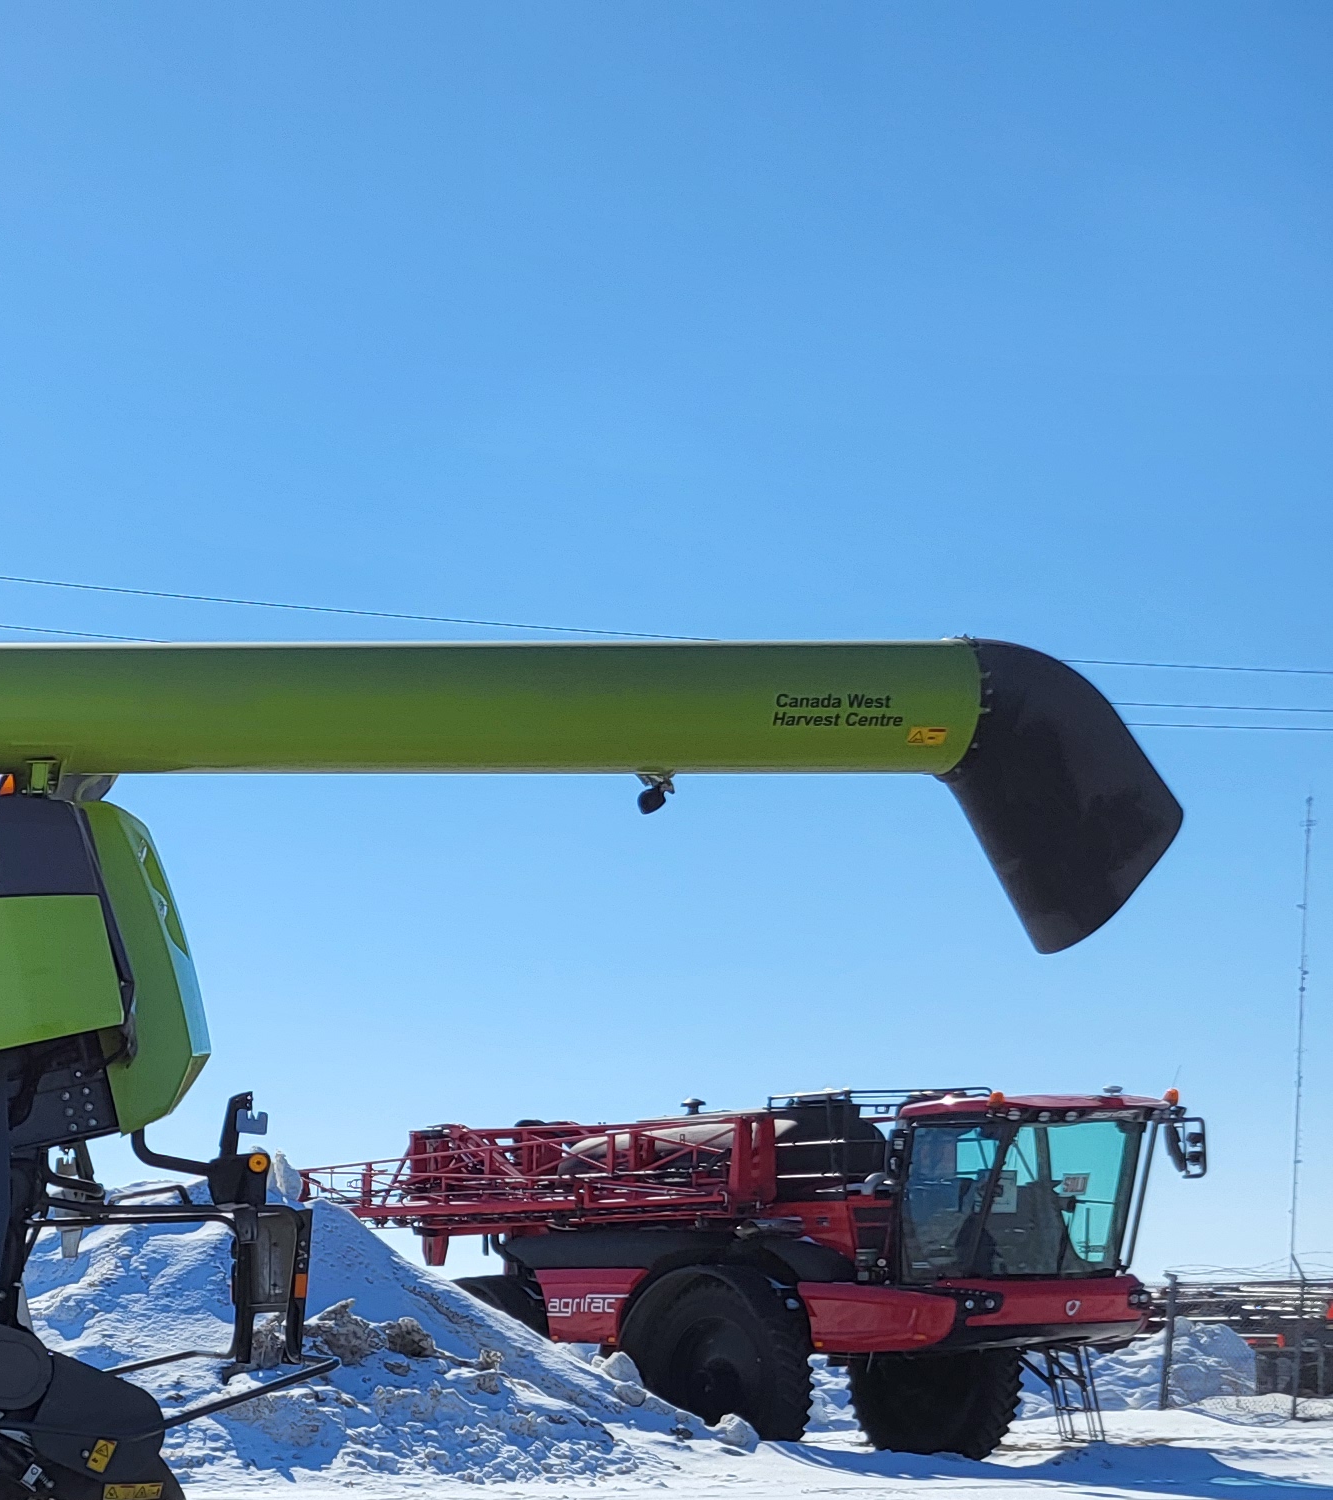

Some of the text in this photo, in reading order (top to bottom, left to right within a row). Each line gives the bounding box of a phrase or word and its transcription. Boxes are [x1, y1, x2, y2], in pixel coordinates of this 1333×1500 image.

[776, 693, 892, 709] Canada West
[773, 711, 904, 727] Harvest Centre
[546, 1293, 630, 1317] agrifac
